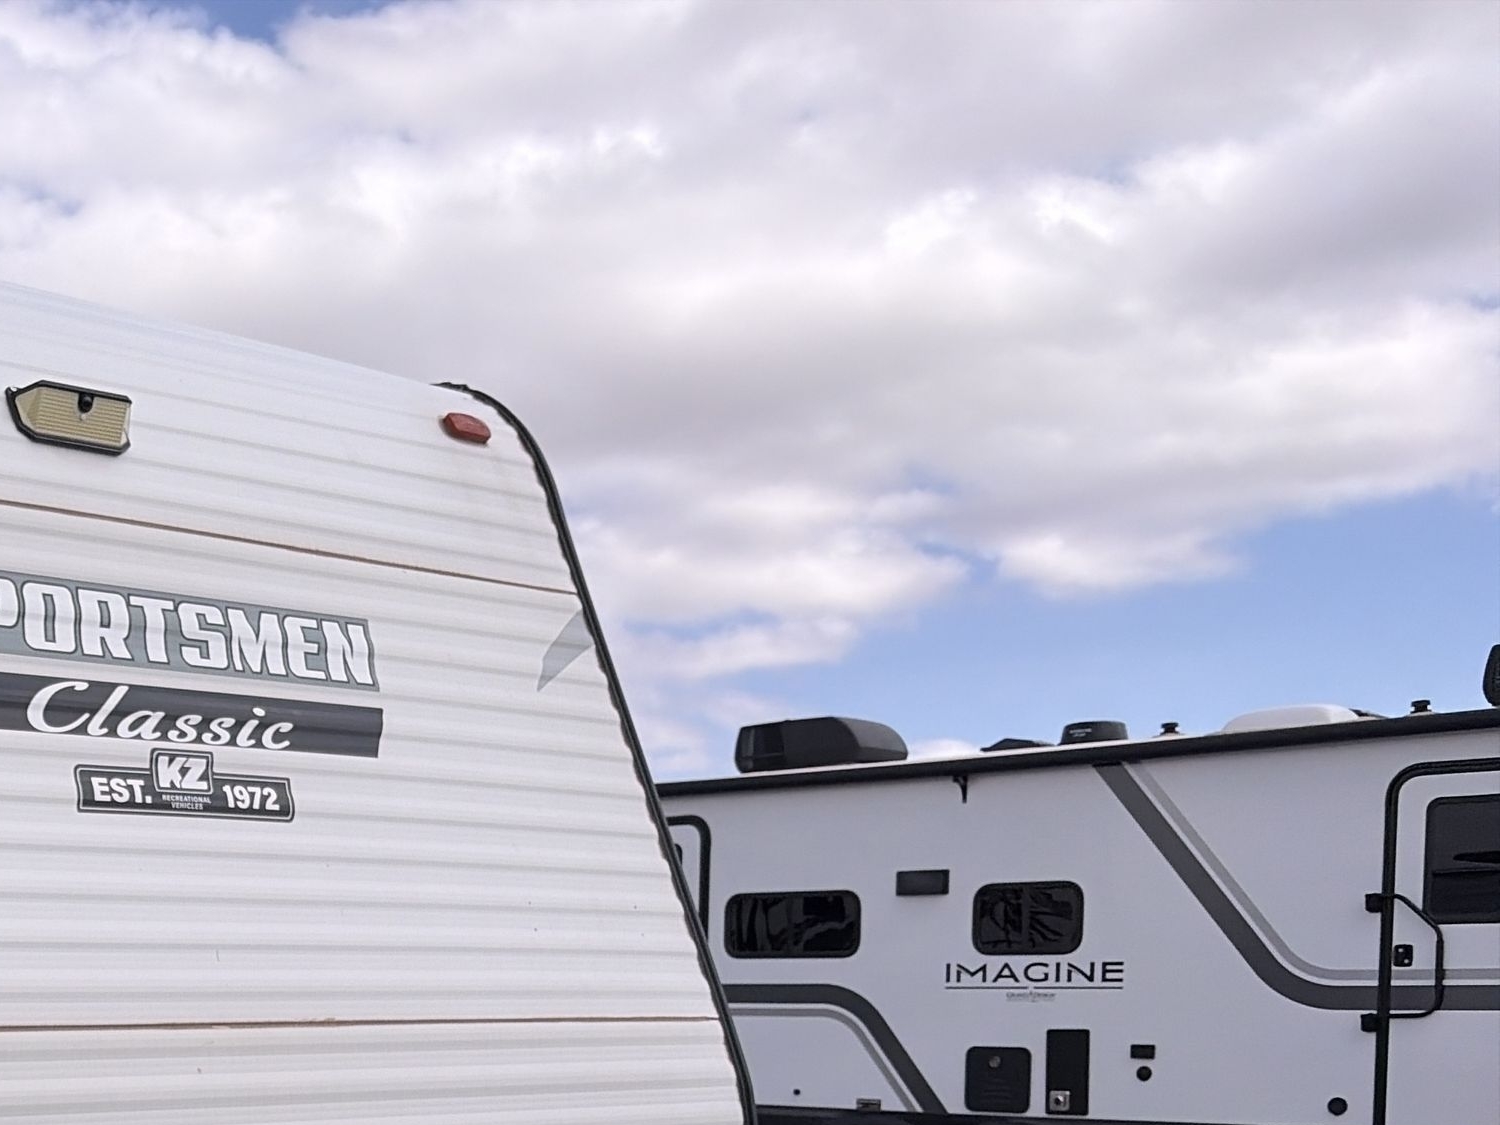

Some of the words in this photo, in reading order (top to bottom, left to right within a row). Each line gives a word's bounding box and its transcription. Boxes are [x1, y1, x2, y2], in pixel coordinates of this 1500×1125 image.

[26, 681, 295, 750] Classic
[157, 755, 208, 790] KZ
[90, 776, 153, 804] EST.
[222, 784, 281, 811] 1972
[162, 794, 212, 804] RECREATIONAL
[171, 801, 204, 811] VEHICLES
[945, 961, 1125, 983] IMAGINE
